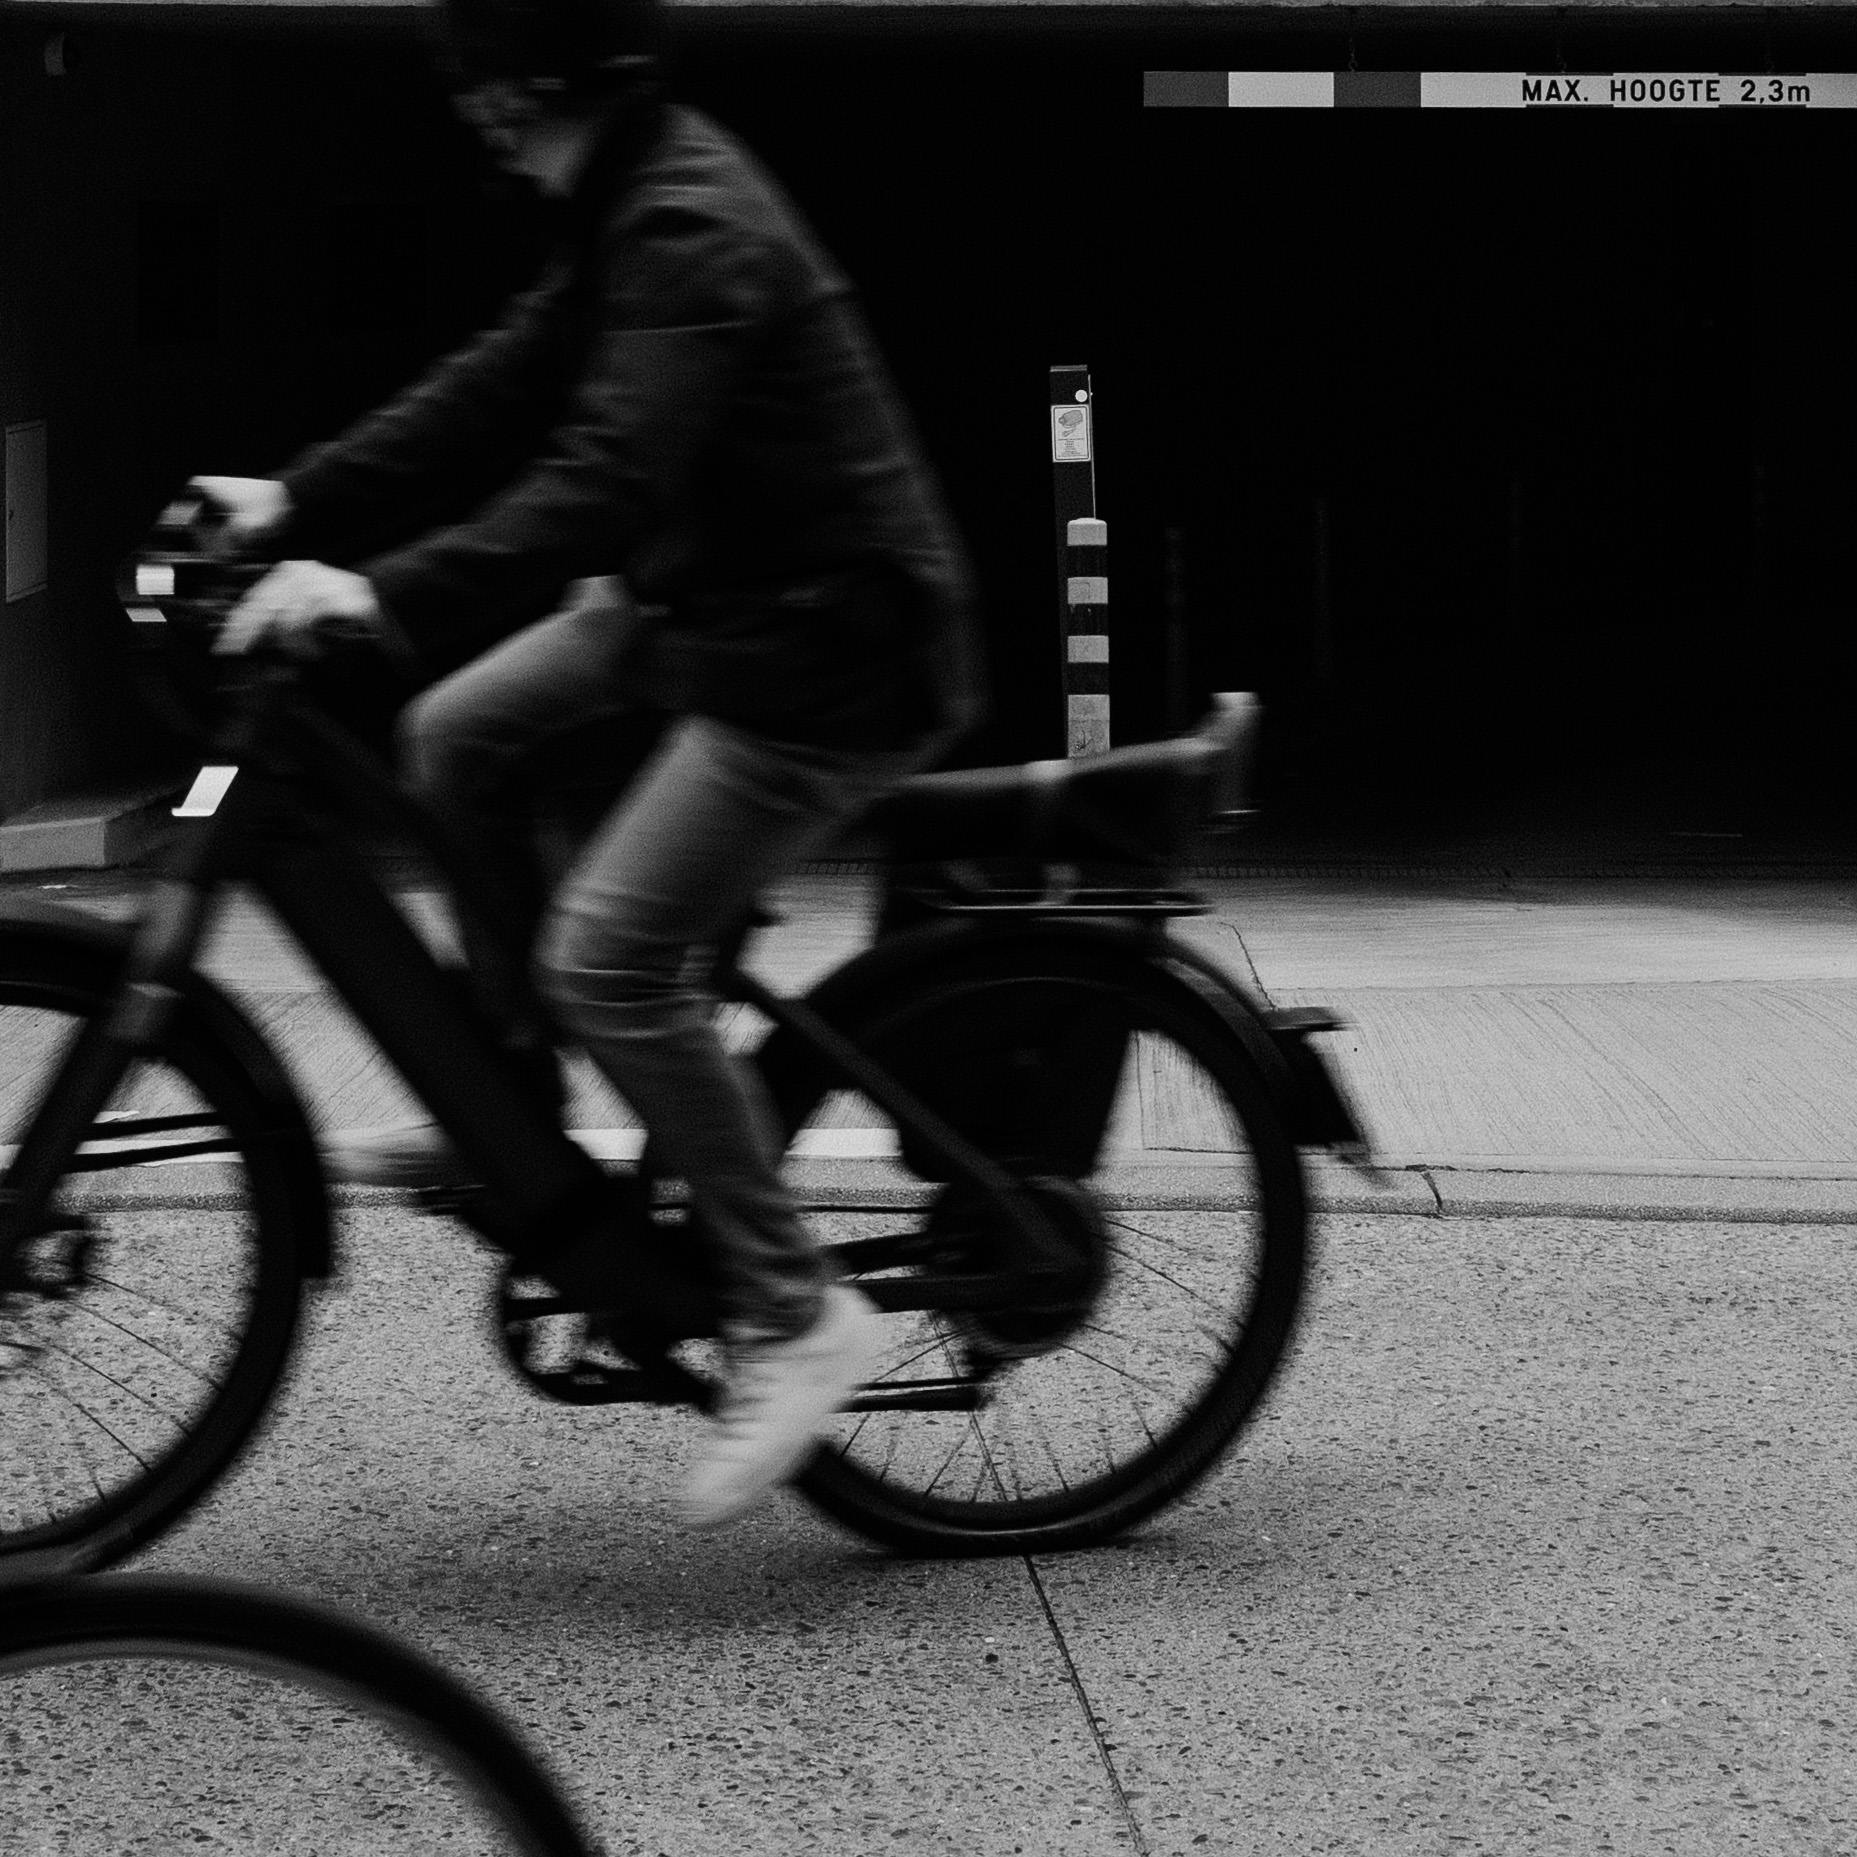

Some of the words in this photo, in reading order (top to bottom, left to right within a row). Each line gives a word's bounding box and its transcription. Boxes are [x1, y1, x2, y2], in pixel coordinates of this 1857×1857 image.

[1522, 79, 1588, 102] MAX.
[1610, 78, 1720, 102] HOOGTE
[1740, 78, 1811, 104] 2,3m
